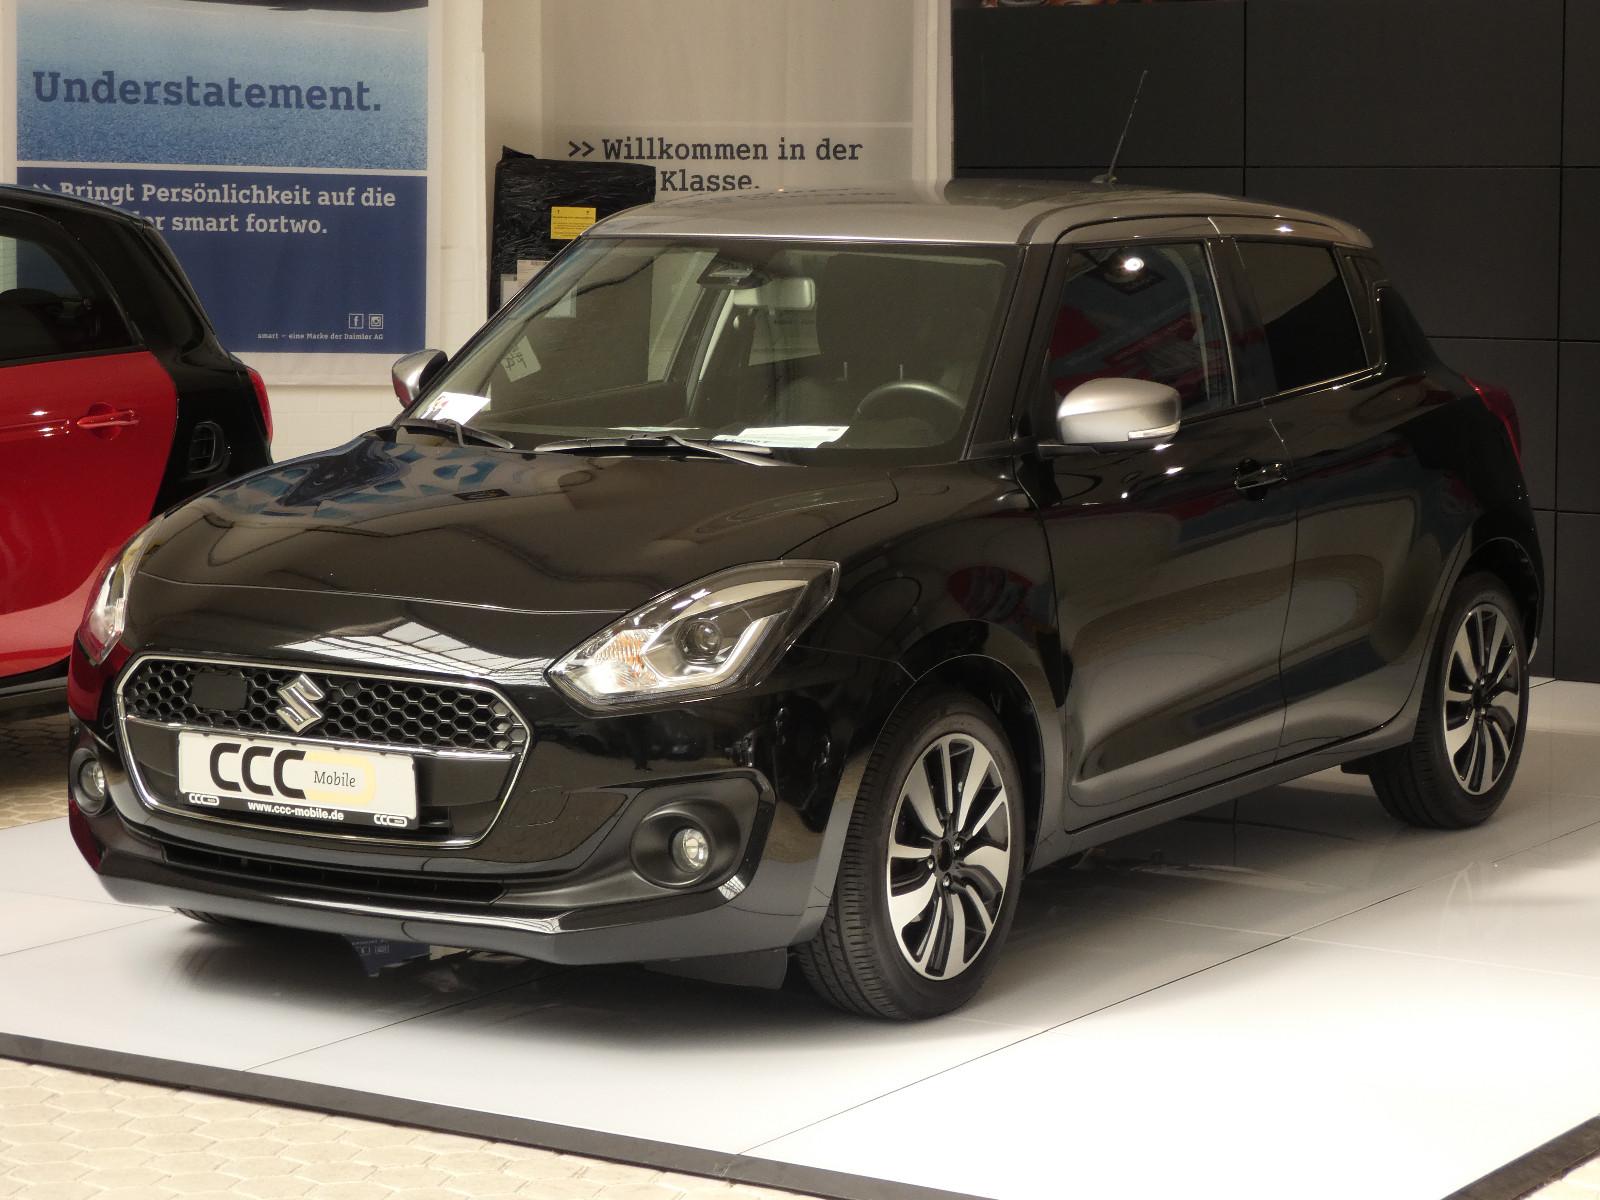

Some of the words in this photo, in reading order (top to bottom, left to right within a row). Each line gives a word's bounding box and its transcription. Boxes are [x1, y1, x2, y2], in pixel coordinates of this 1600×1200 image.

[33, 70, 381, 112] Understatement.
[602, 137, 769, 161] Willkommen
[777, 137, 806, 161] in
[815, 138, 864, 161] der
[660, 169, 761, 192] Klasse.
[60, 180, 135, 206] Bringt
[142, 182, 312, 206] Persönlichkeit
[317, 187, 356, 206] auf
[361, 187, 397, 207] die
[172, 213, 239, 232] smart
[246, 213, 328, 234] fortwo.
[257, 332, 279, 340] smart
[288, 332, 305, 340] eine
[306, 331, 329, 340] Marke
[330, 331, 342, 340] der
[209, 742, 307, 800] CCC
[313, 770, 357, 788] Mobile
[247, 801, 345, 821] www.ccc-mobile.de
